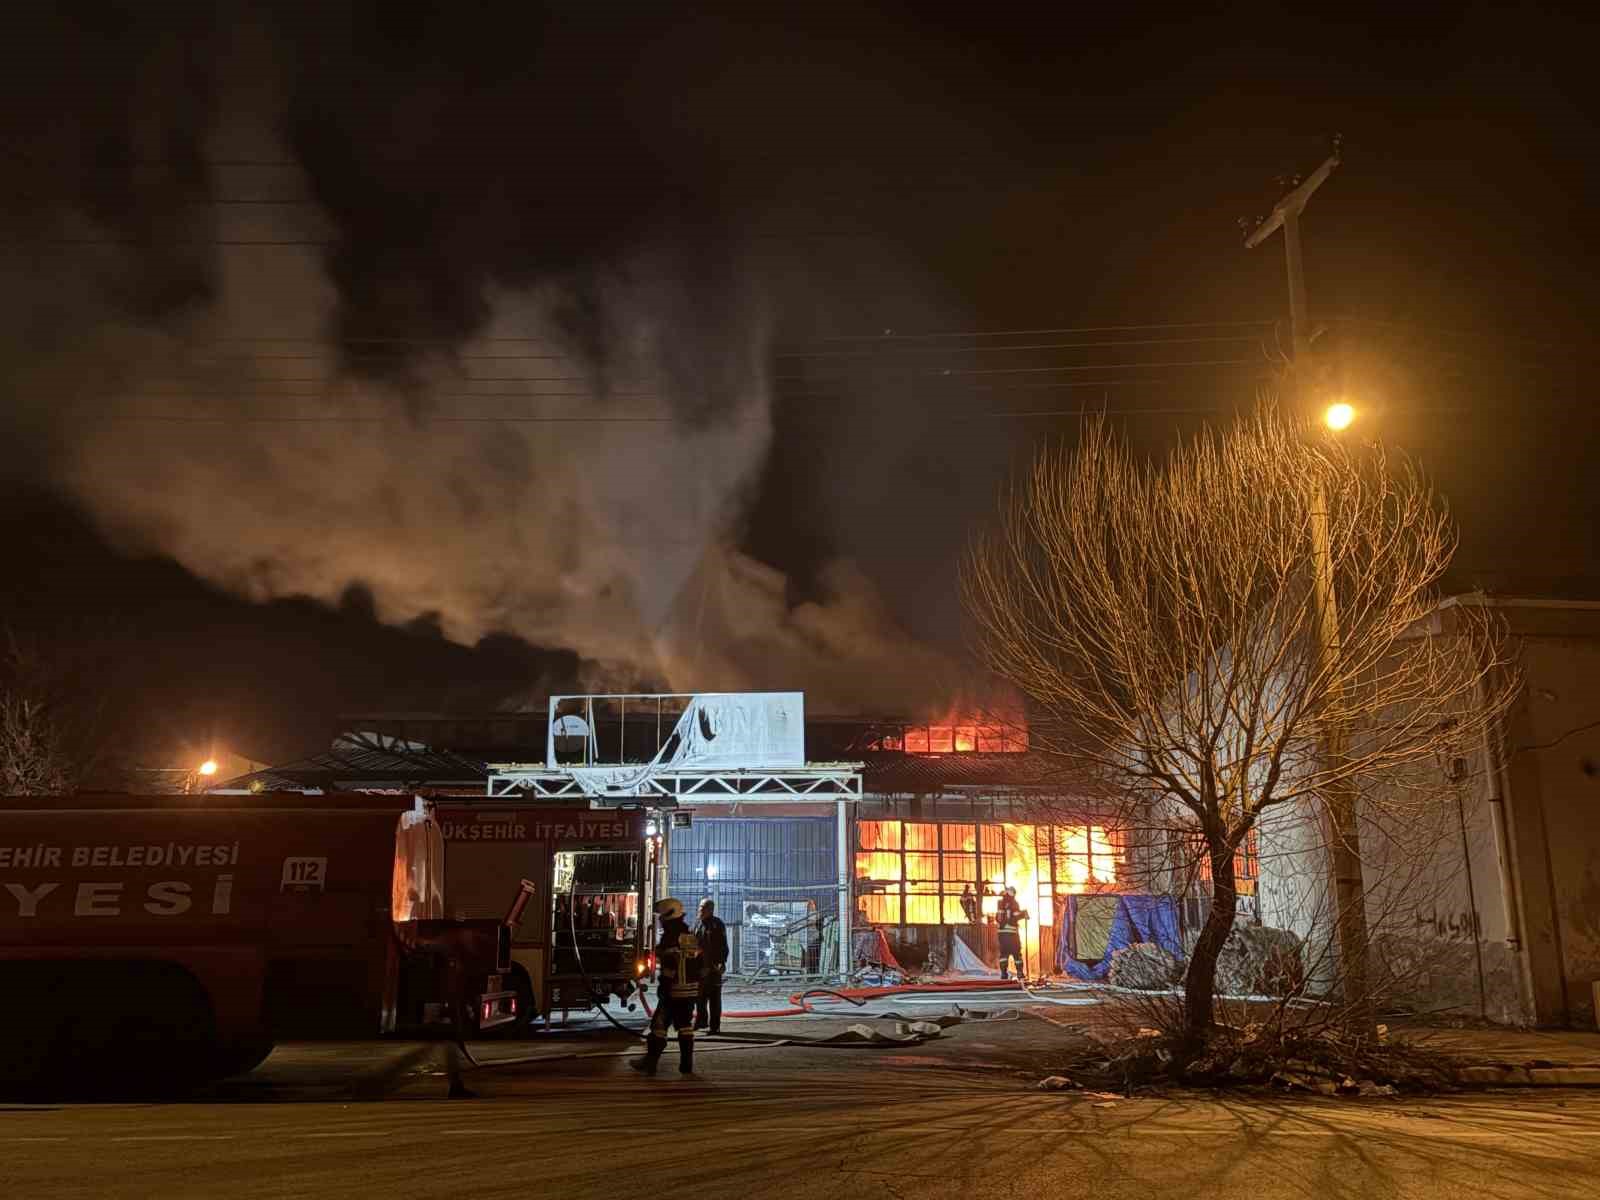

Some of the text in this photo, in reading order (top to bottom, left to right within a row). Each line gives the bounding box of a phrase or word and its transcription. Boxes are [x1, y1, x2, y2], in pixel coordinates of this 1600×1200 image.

[535, 819, 631, 840] İTFAİYESİ
[71, 841, 241, 868] BELEDİYESİ
[290, 861, 319, 881] 112
[2, 872, 235, 918] YESİ
